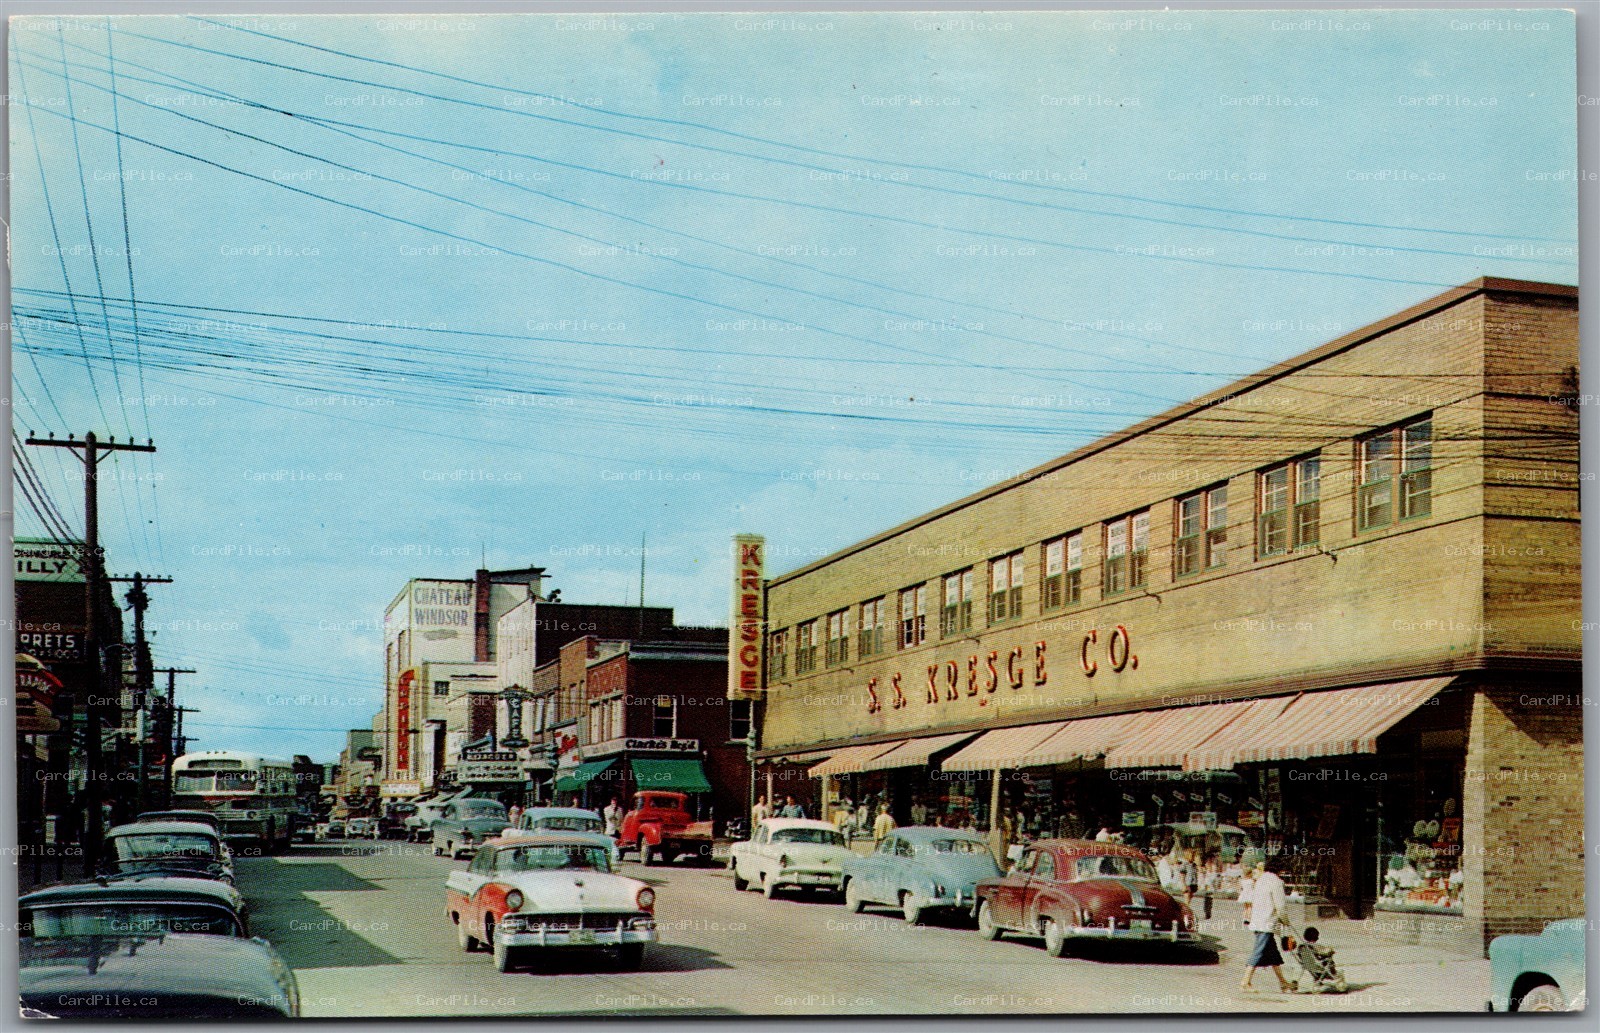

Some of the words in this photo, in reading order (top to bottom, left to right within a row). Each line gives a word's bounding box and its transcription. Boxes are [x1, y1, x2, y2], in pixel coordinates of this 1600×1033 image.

[414, 588, 471, 605] CHATEAU
[415, 608, 469, 625] WINDSOR
[739, 543, 761, 690] KRESGE
[927, 641, 1047, 704] KRESGE
[1080, 624, 1139, 678] CO.
